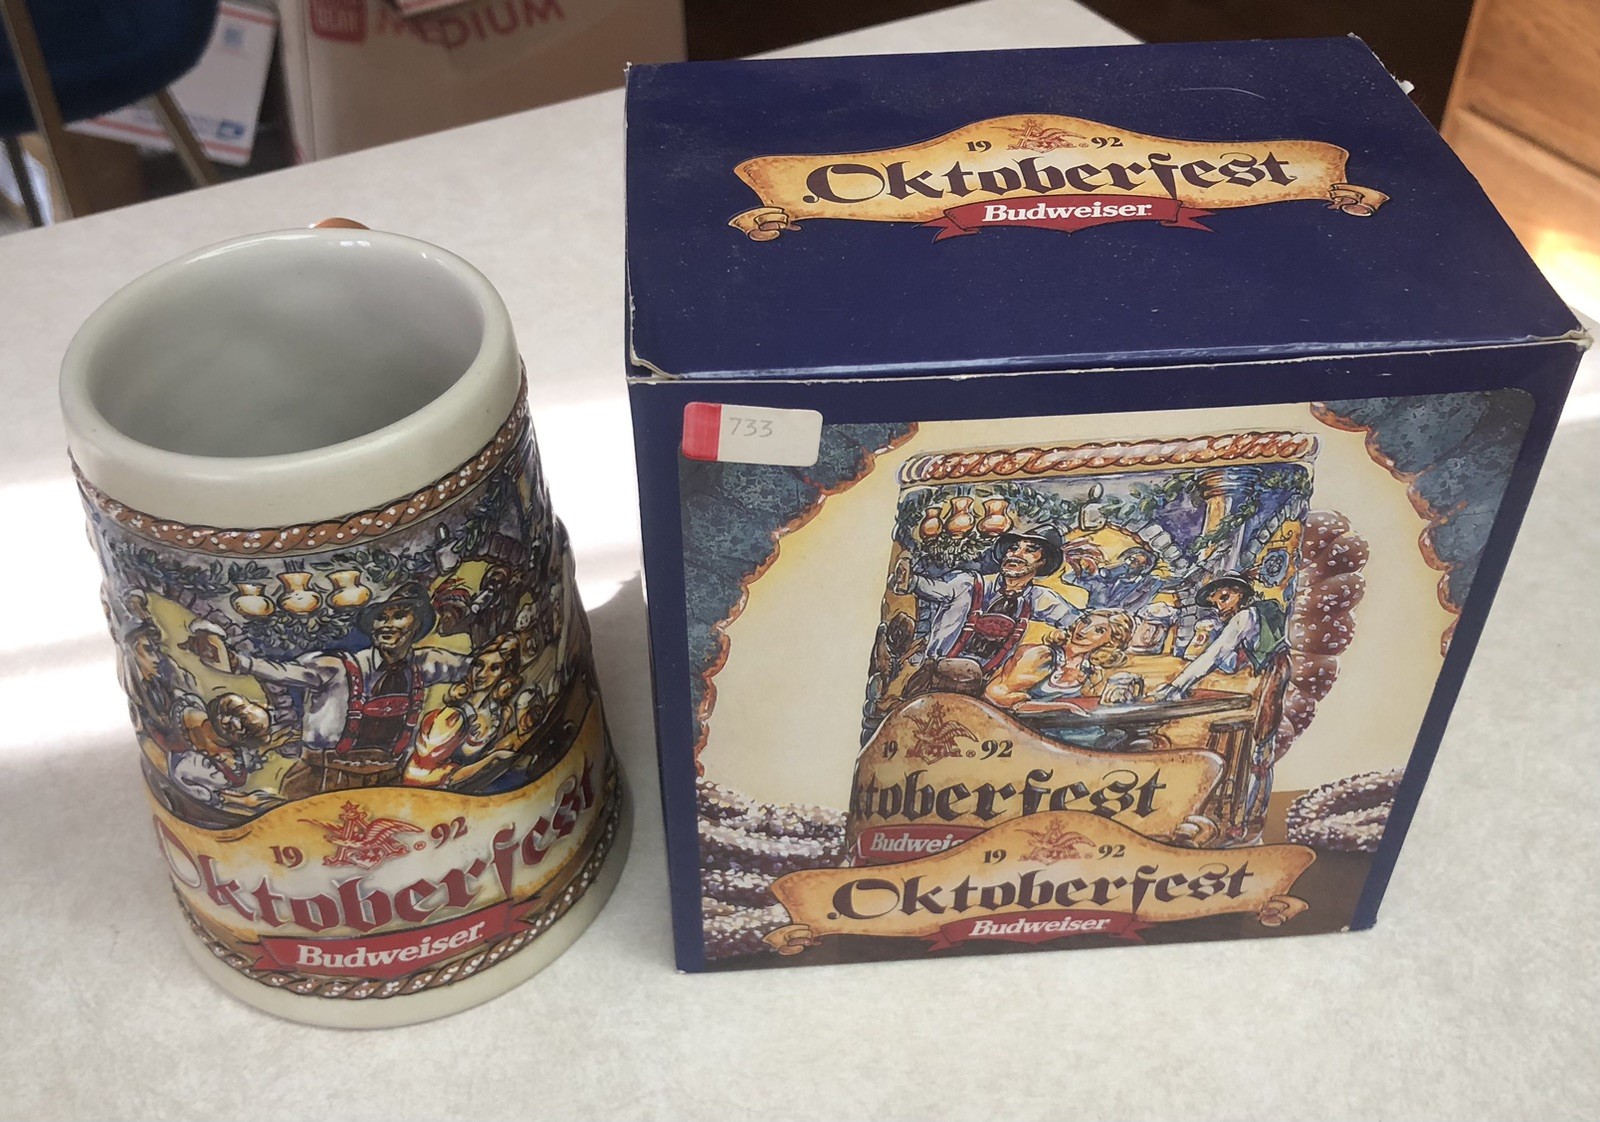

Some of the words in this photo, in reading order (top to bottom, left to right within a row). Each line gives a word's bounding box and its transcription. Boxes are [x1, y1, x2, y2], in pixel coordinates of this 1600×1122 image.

[966, 140, 992, 152] 19
[1090, 136, 1123, 148] 92
[803, 151, 1297, 204] Oktoberfest
[982, 202, 1152, 223] Budweiser
[729, 417, 774, 438] 733
[882, 740, 899, 761] 19
[980, 740, 1013, 761] 92
[272, 845, 303, 868] 19
[431, 816, 467, 848] 92
[983, 849, 1007, 865] 19
[1098, 844, 1126, 860] 92
[827, 860, 1255, 921] Oktoberfest
[967, 916, 1112, 937] Budweiser
[296, 920, 484, 968] Budweiser
